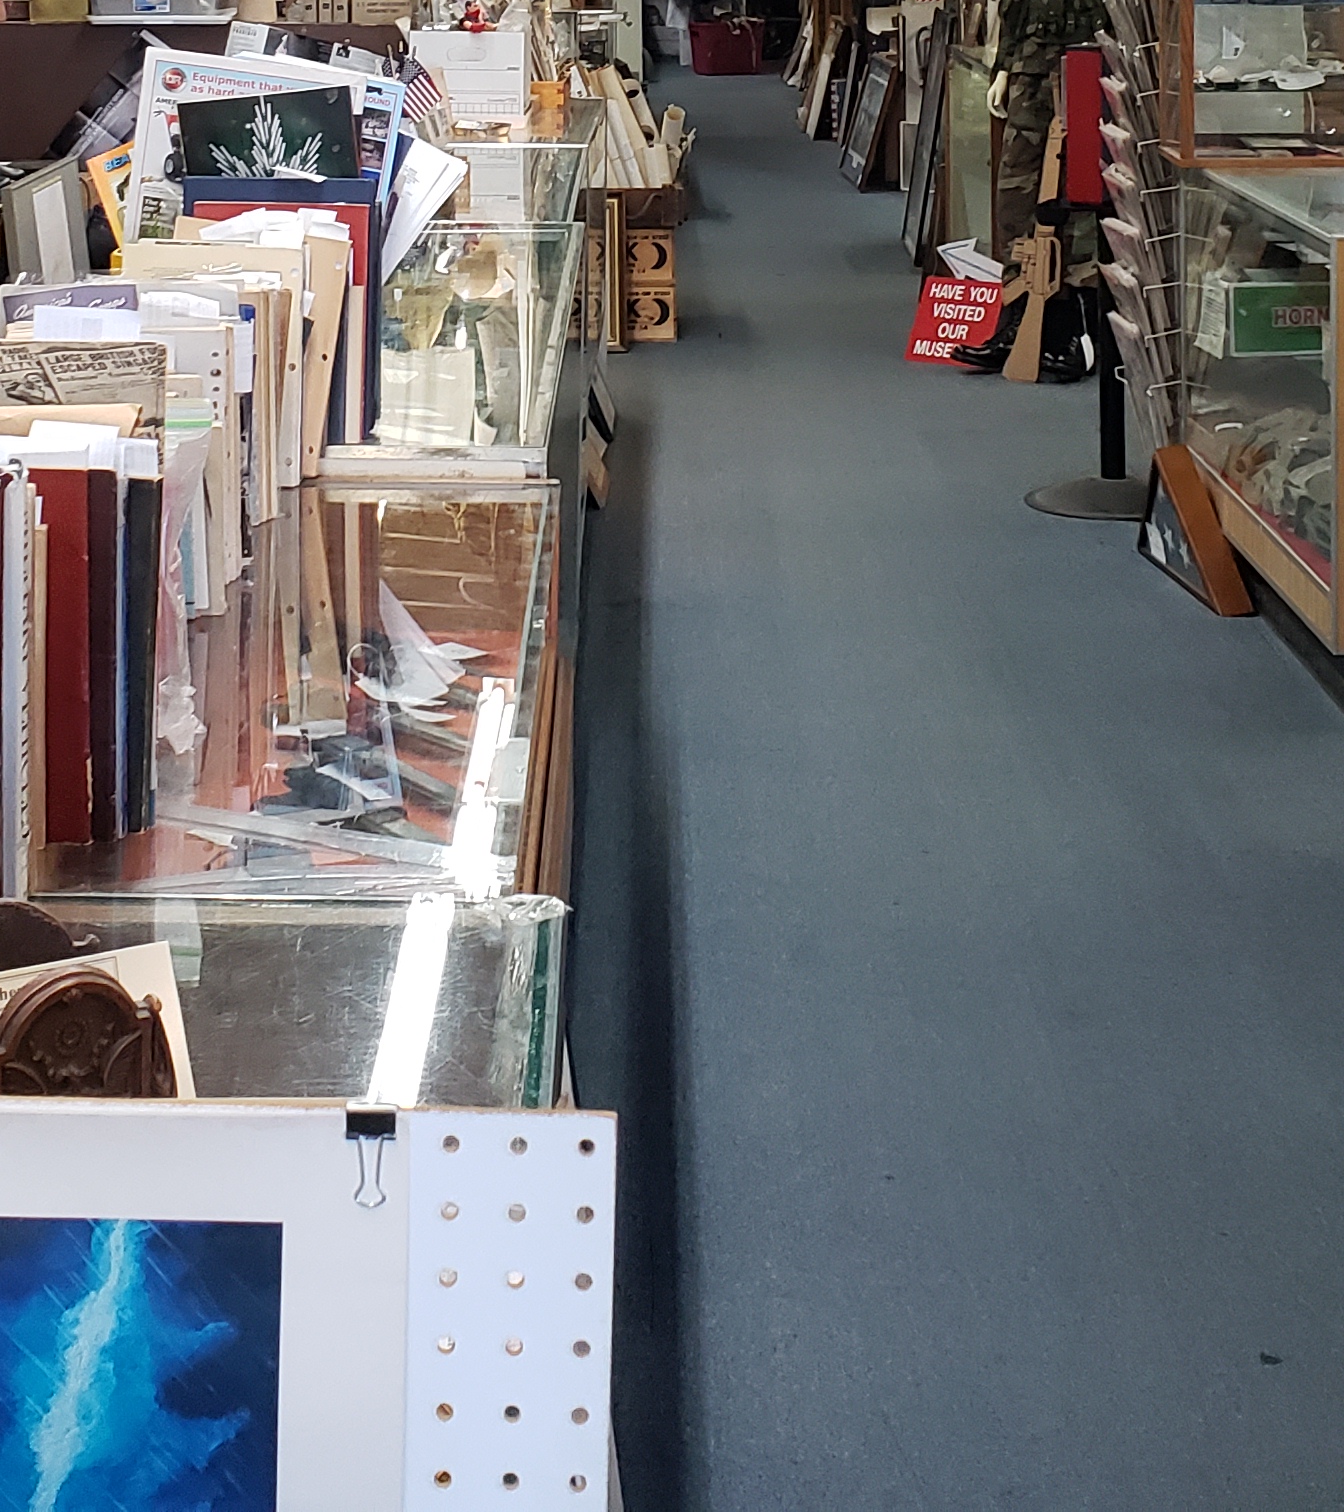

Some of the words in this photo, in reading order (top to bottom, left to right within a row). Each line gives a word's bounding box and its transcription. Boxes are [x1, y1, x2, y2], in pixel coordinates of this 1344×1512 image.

[191, 85, 204, 93] as
[207, 86, 235, 96] hard
[192, 72, 256, 89] Equipment
[258, 81, 283, 92] that
[929, 281, 965, 303] HAVE
[969, 283, 999, 304] YOU
[933, 301, 986, 323] VISITED
[1273, 308, 1331, 326] HORN
[937, 321, 969, 341] OUR
[45, 351, 83, 365] LARGE
[86, 347, 137, 362] BRITISH
[912, 338, 956, 360] MUSE
[50, 361, 108, 375] ESCAPED
